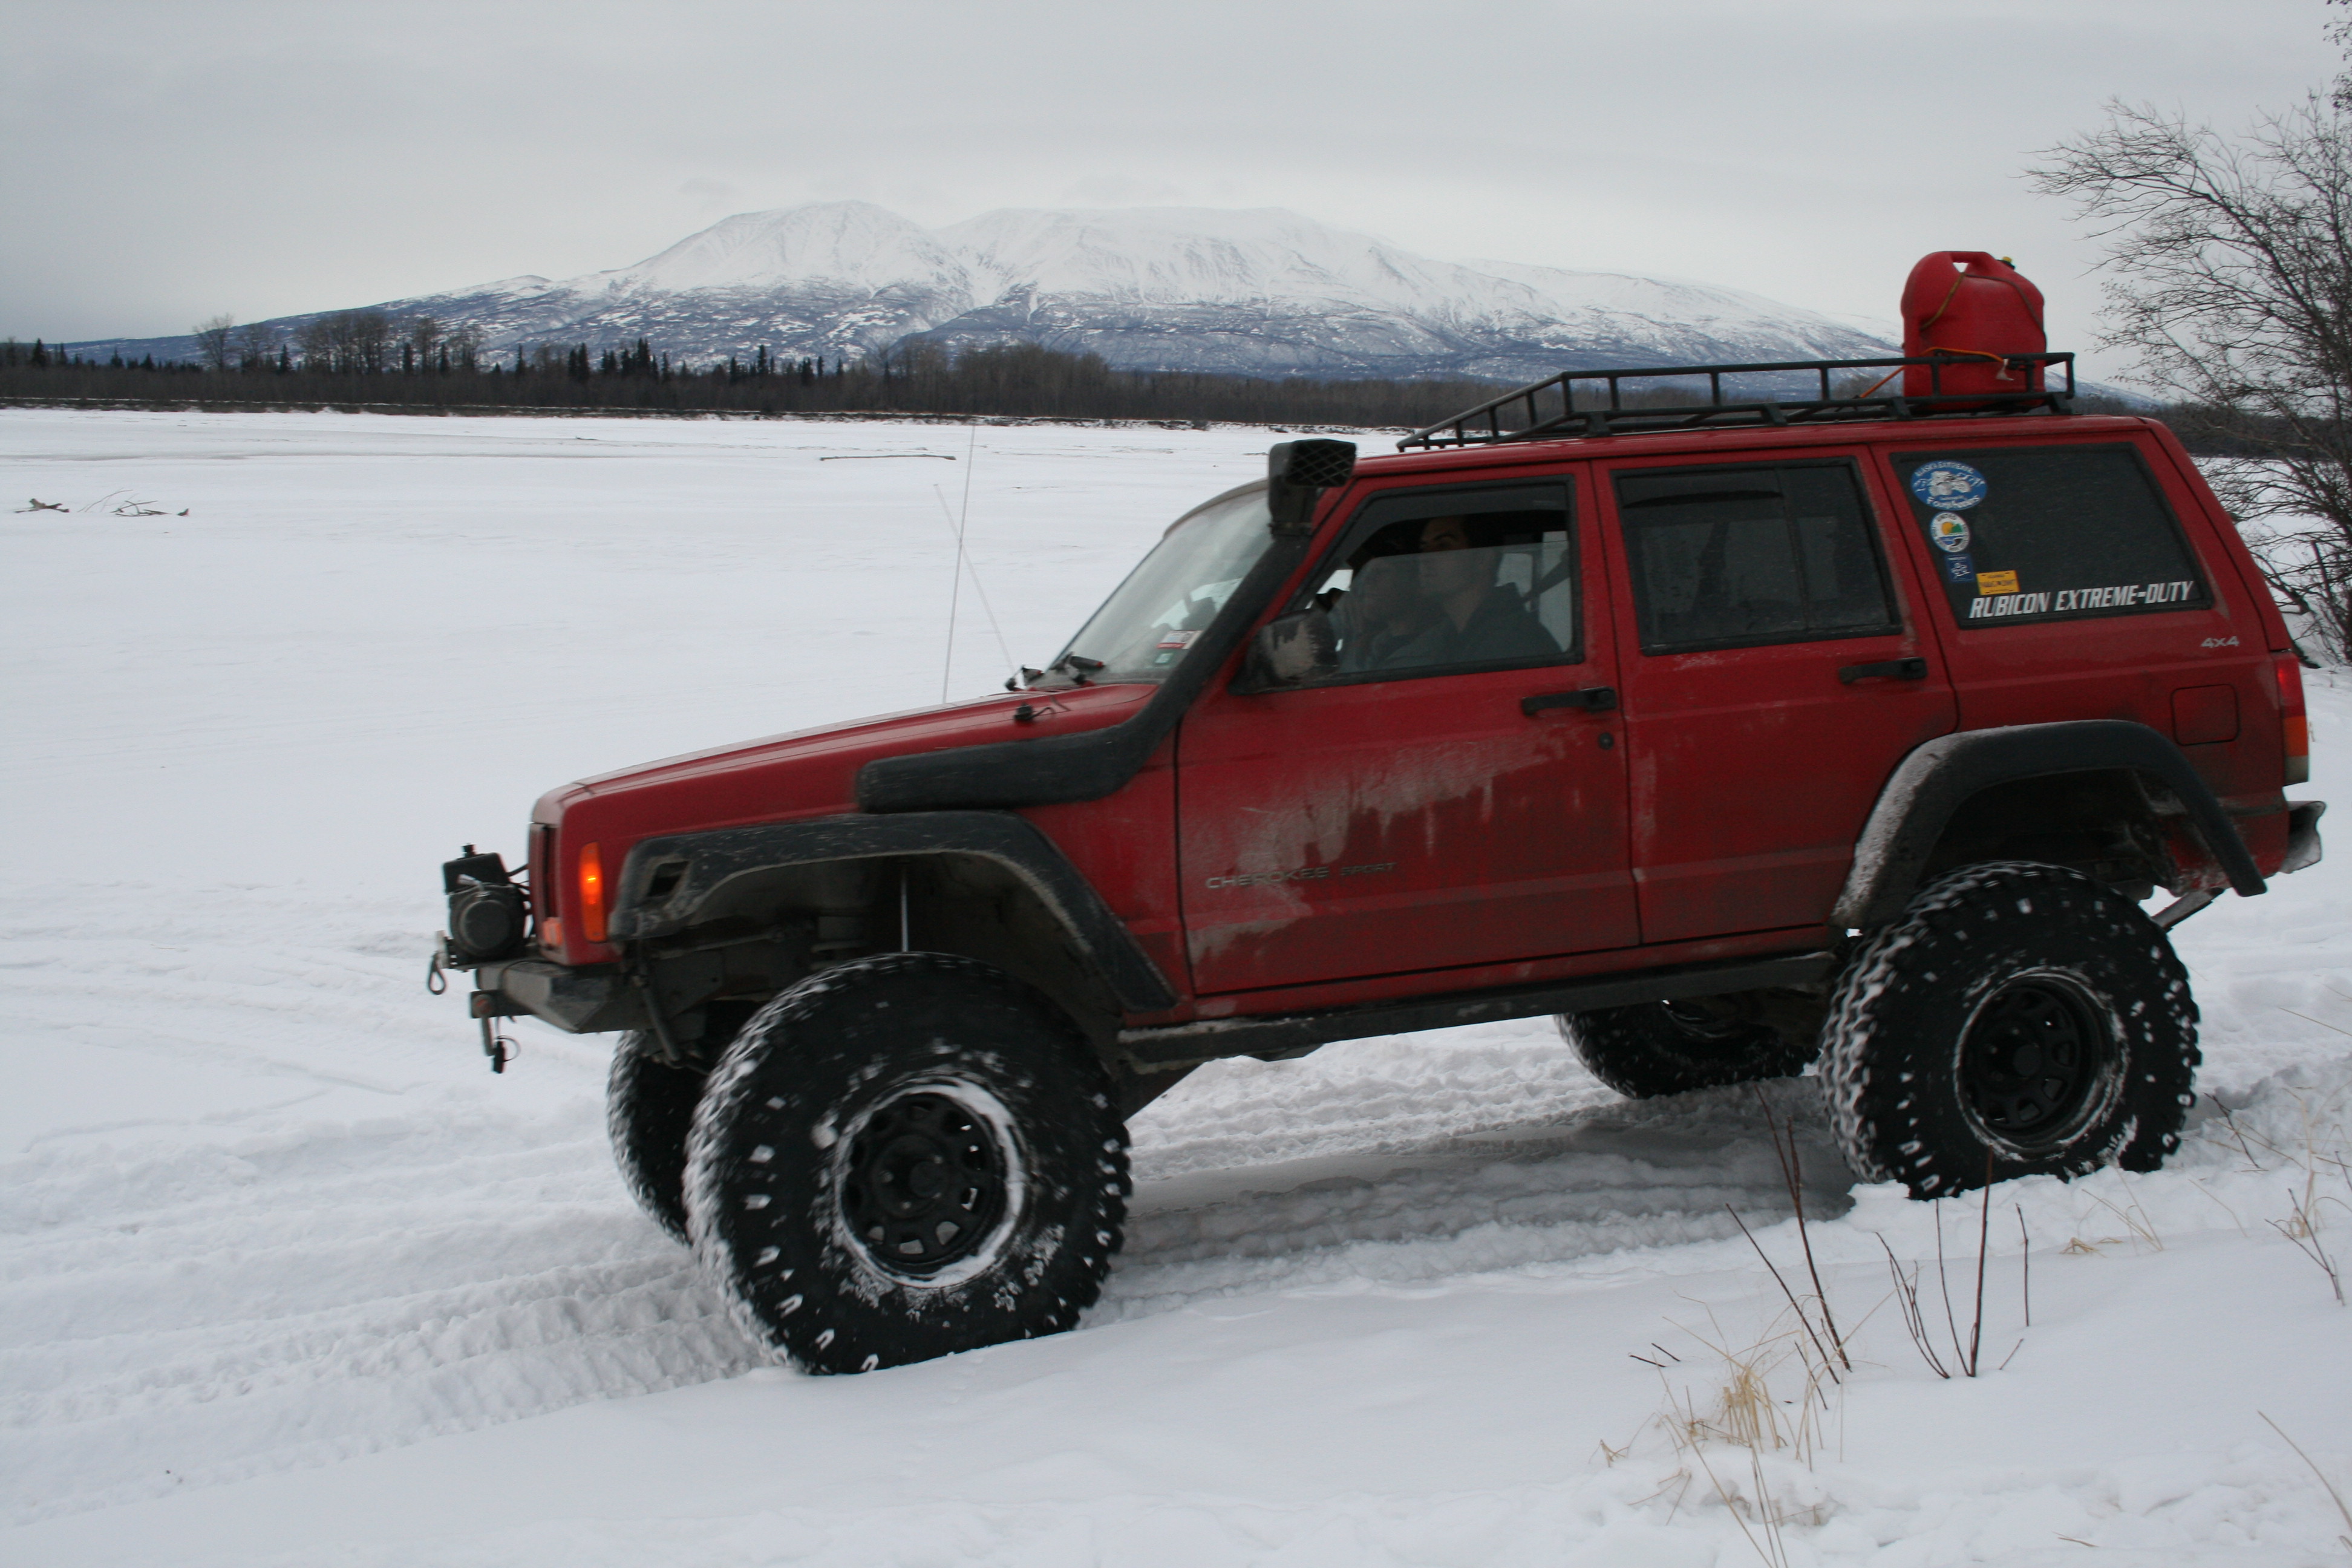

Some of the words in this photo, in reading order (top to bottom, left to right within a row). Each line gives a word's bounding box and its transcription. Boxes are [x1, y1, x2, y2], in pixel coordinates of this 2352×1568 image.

[1969, 592, 2051, 618] RUBICON
[2054, 581, 2194, 612] EXTREME-DUTY
[1206, 866, 1329, 889] CHEROKEE
[1340, 862, 1397, 876] SPORT
